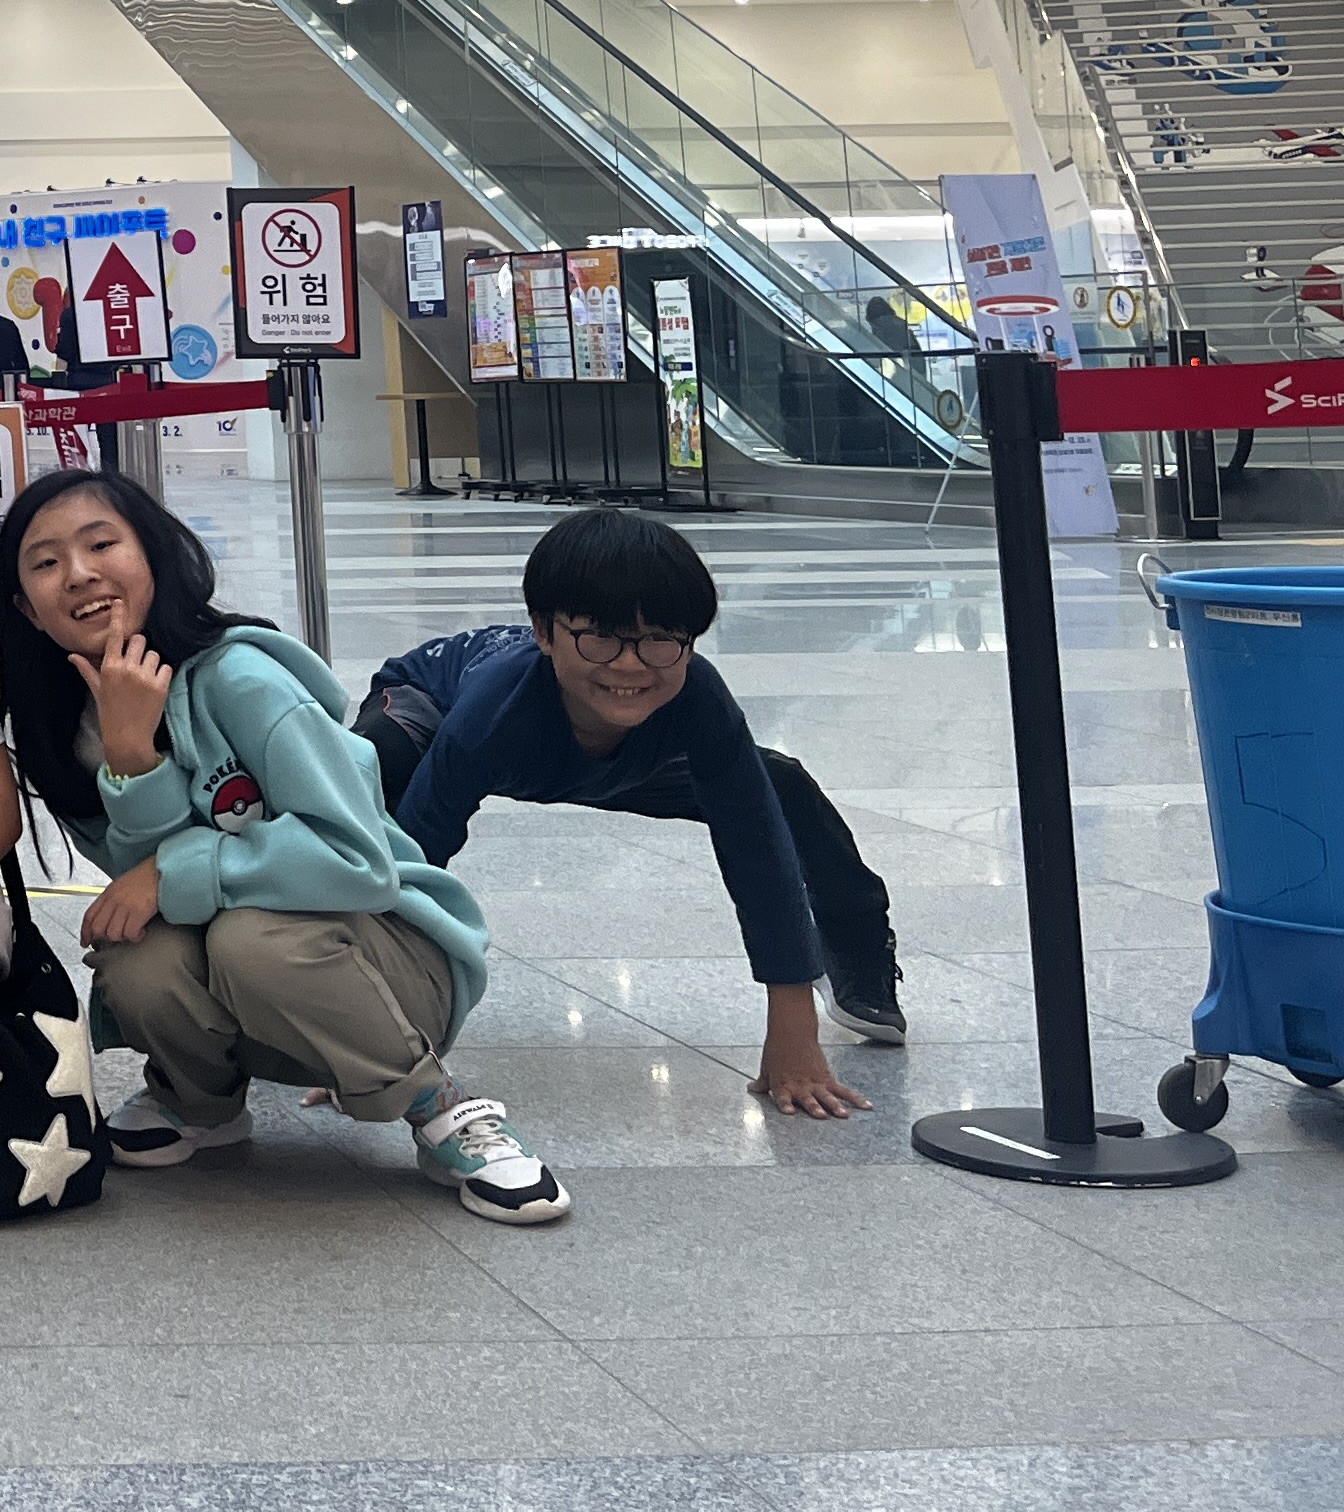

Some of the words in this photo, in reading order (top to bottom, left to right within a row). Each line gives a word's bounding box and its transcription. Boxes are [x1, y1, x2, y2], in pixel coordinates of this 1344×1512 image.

[259, 272, 328, 307] 위험
[106, 283, 134, 340] 출구
[262, 313, 300, 325] 들어가지
